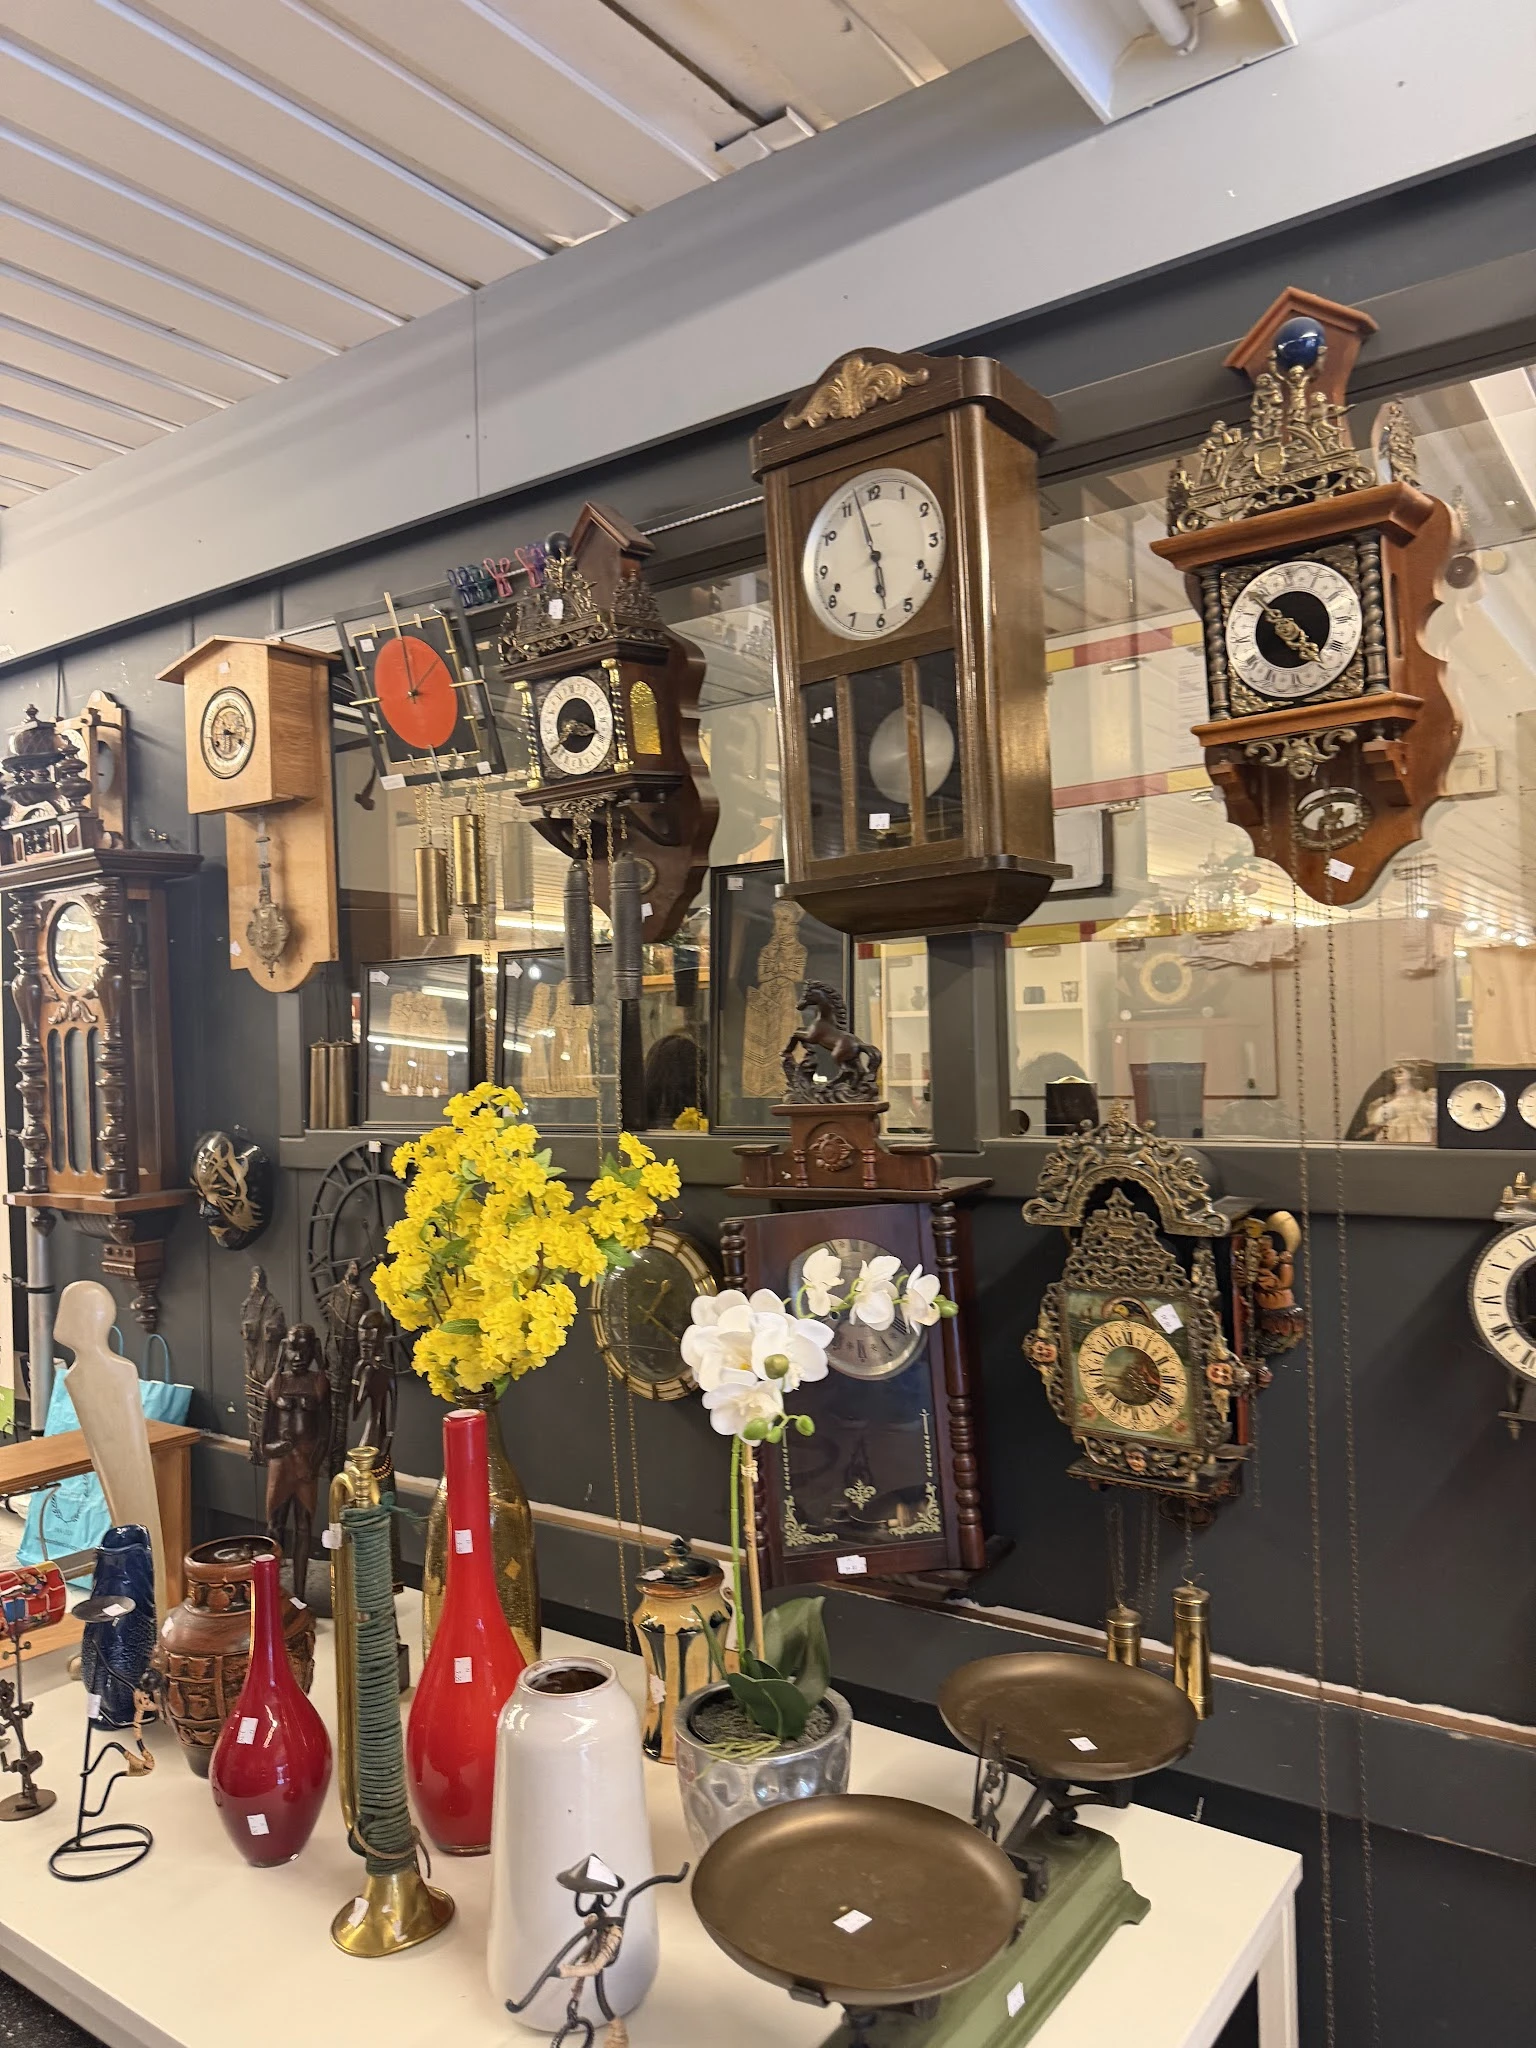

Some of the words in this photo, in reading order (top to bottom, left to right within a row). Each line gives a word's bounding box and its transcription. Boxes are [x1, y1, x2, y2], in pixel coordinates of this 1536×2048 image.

[867, 484, 881, 502] 12
[899, 487, 906, 500] 1
[841, 502, 853, 518] 11
[919, 502, 930, 517] 2
[823, 530, 837, 547] 10
[929, 532, 939, 549] 3
[819, 564, 829, 578] 9
[922, 569, 933, 583] 4
[828, 595, 837, 610] 8
[903, 597, 914, 613] 5
[848, 612, 857, 628] 7
[876, 613, 887, 629] 6
